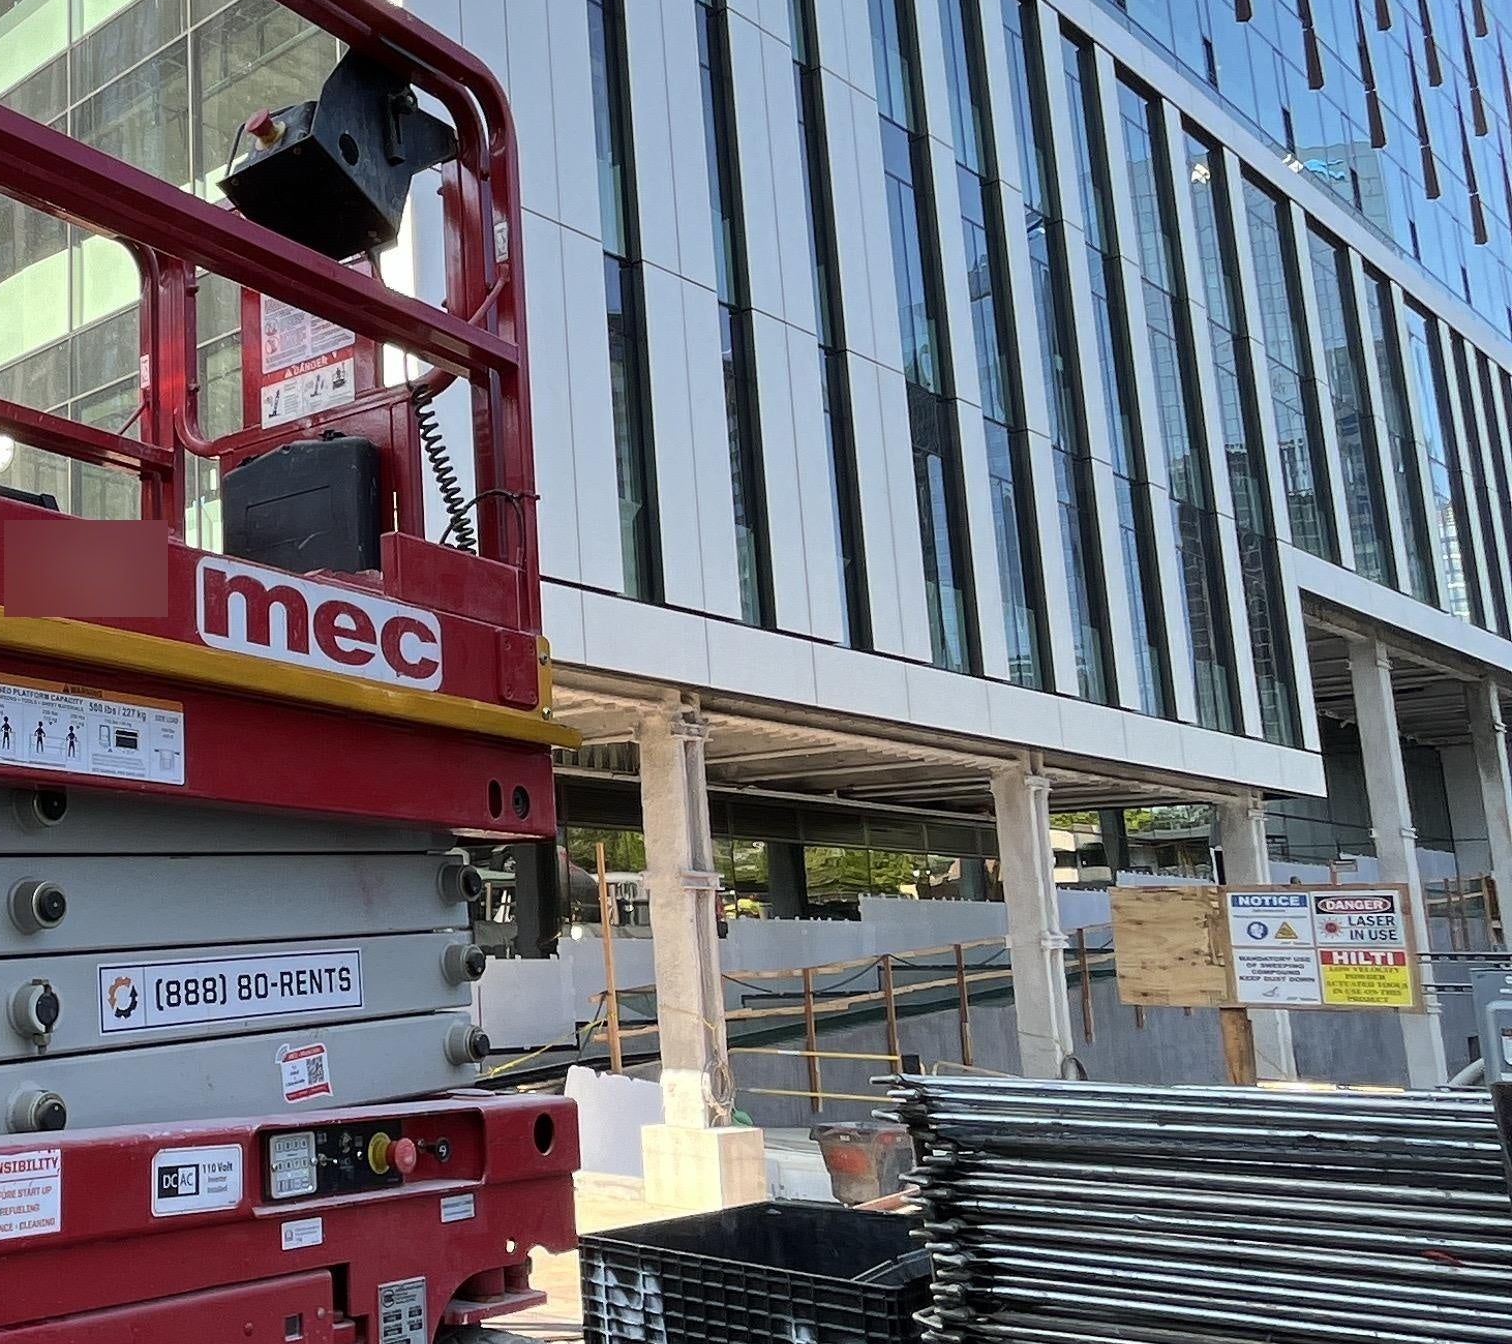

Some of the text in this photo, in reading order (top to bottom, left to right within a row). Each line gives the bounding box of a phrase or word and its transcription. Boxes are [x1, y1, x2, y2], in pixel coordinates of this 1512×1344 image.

[292, 355, 328, 376] DANGER
[203, 564, 441, 681] mec
[13, 688, 50, 700] PLATFORM
[50, 694, 84, 706] CAPACITY
[122, 706, 136, 717] 227
[137, 710, 147, 722] kg
[1238, 896, 1301, 906] NOTICE
[1325, 900, 1384, 910] DANGER
[1347, 915, 1396, 927] LASER
[1349, 929, 1398, 941] IN USE
[1331, 951, 1395, 965] HILTI
[154, 964, 352, 1010] (888) 80-RENTS
[202, 1161, 233, 1175] 110 Volt
[162, 1174, 178, 1189] DC
[179, 1172, 194, 1187] AC
[17, 1187, 40, 1198] START
[41, 1185, 53, 1195] UP
